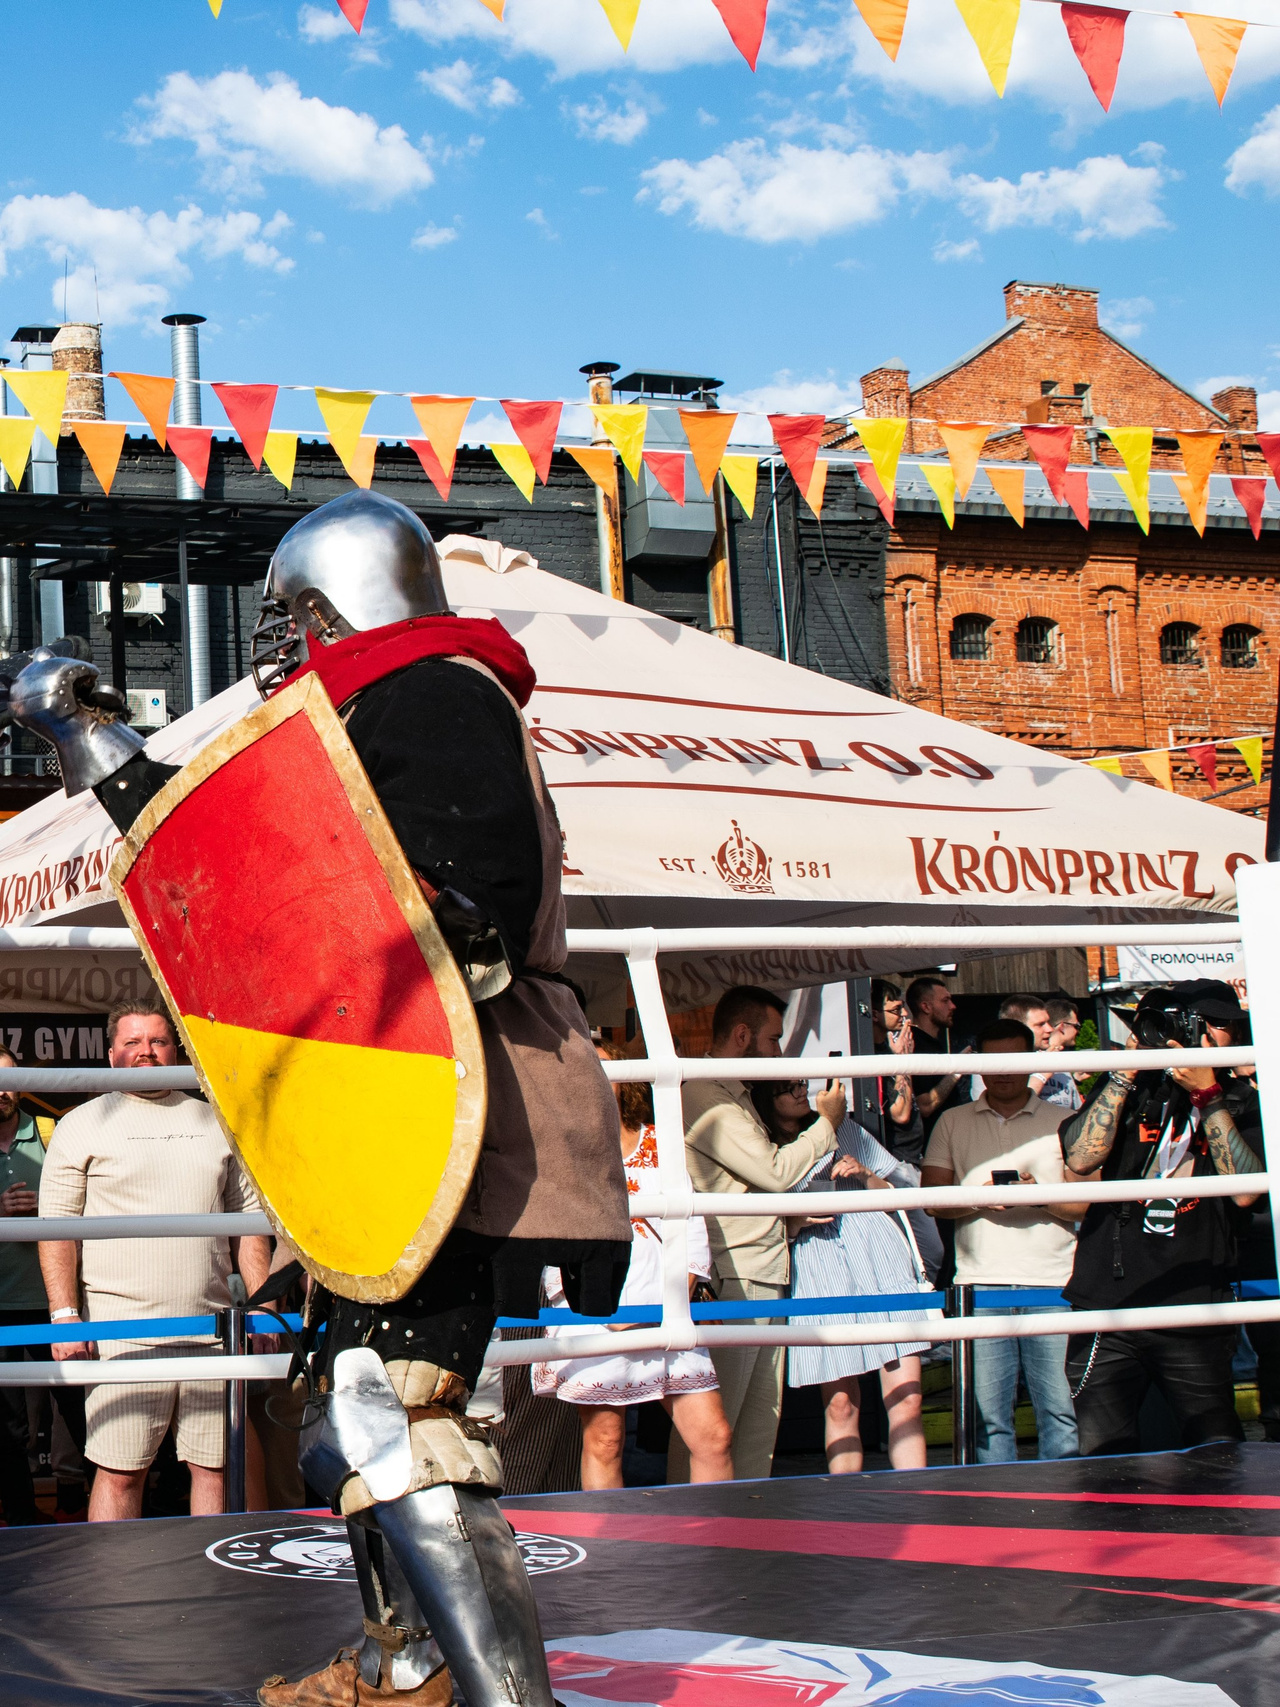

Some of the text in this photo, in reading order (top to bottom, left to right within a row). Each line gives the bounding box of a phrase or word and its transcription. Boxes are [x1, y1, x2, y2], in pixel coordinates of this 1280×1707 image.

[528, 717, 855, 772] ÓNPRINZ
[658, 857, 832, 879] EST. 1581
[907, 831, 1215, 900] KRÓNPRINZ
[1150, 953, 1235, 964] РЮМОЧНАЯ
